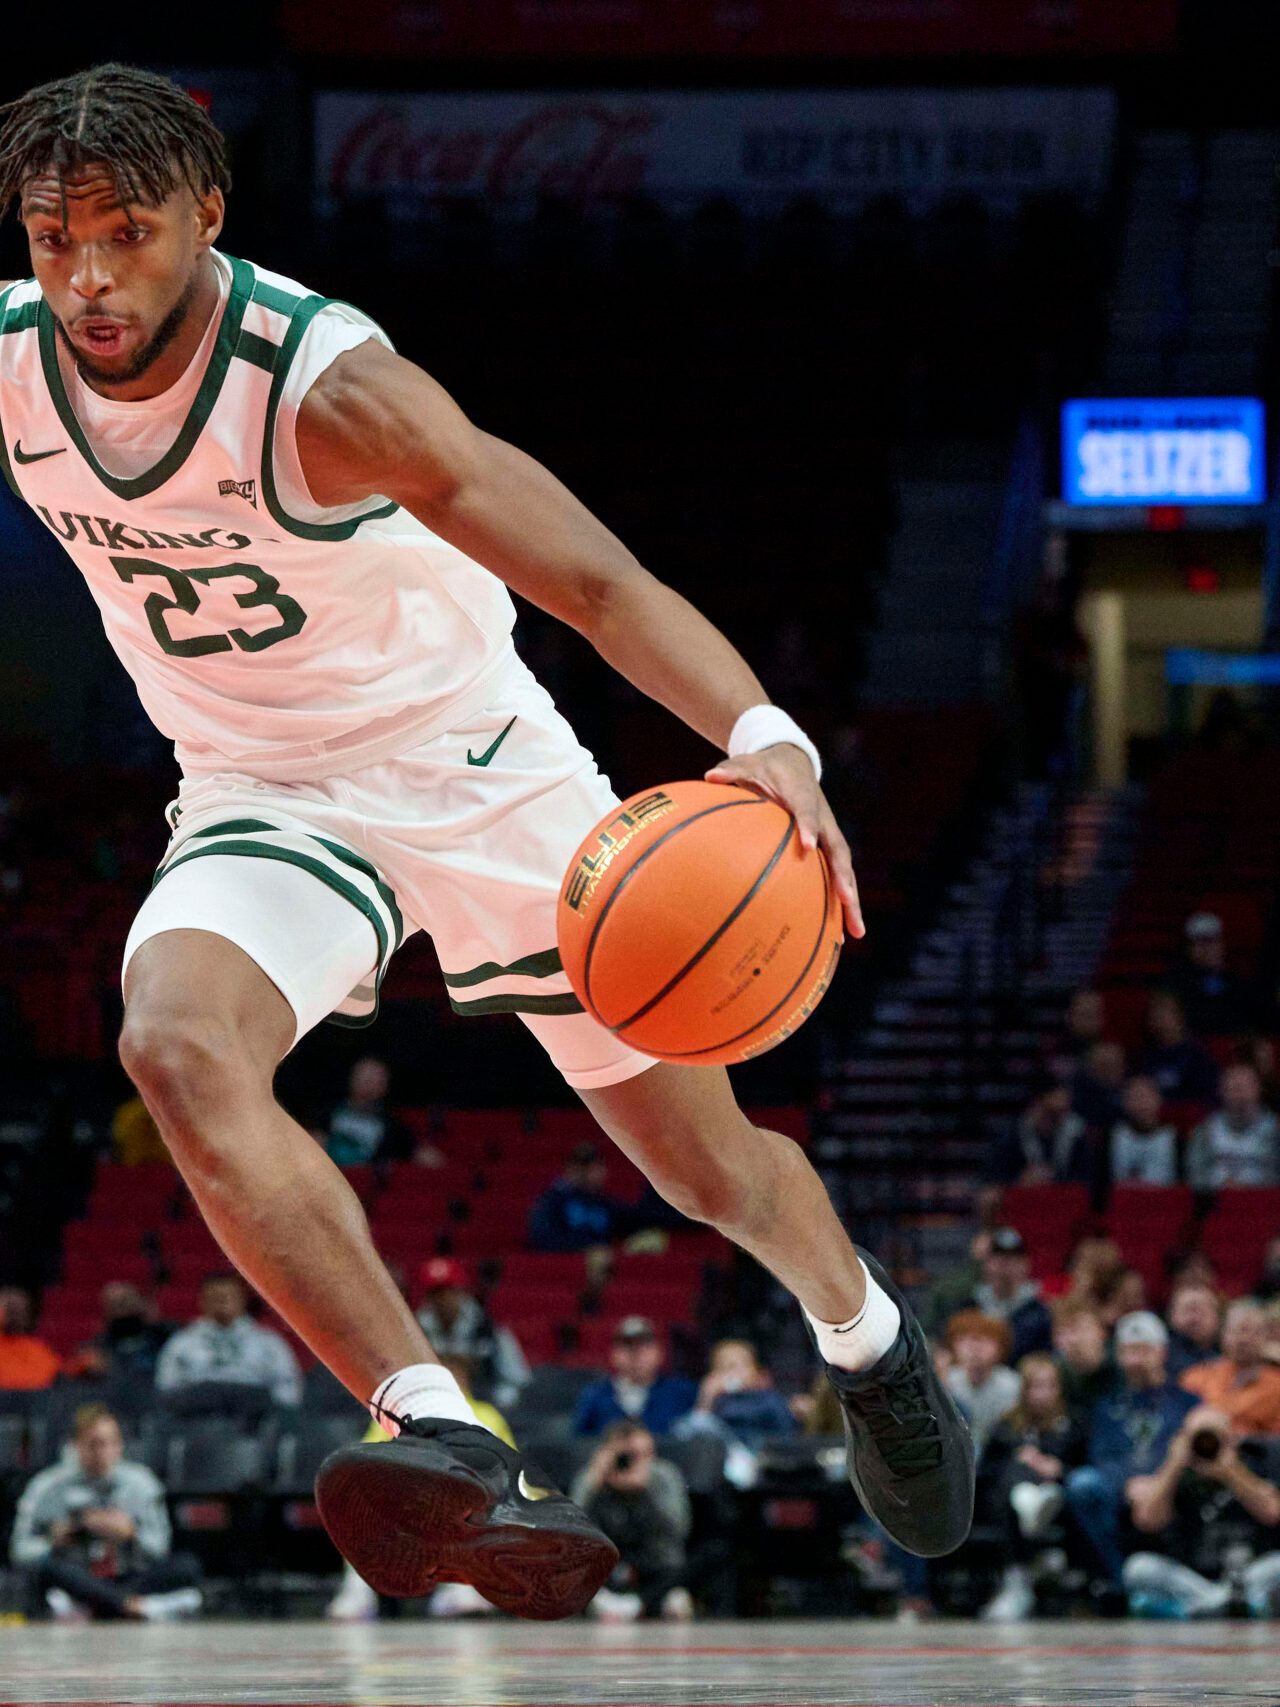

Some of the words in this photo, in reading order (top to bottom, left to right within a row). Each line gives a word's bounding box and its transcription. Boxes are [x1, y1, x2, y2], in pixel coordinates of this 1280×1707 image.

[1077, 429, 1252, 497] SELTZER
[35, 504, 280, 551] VIKING
[108, 555, 308, 658] 23
